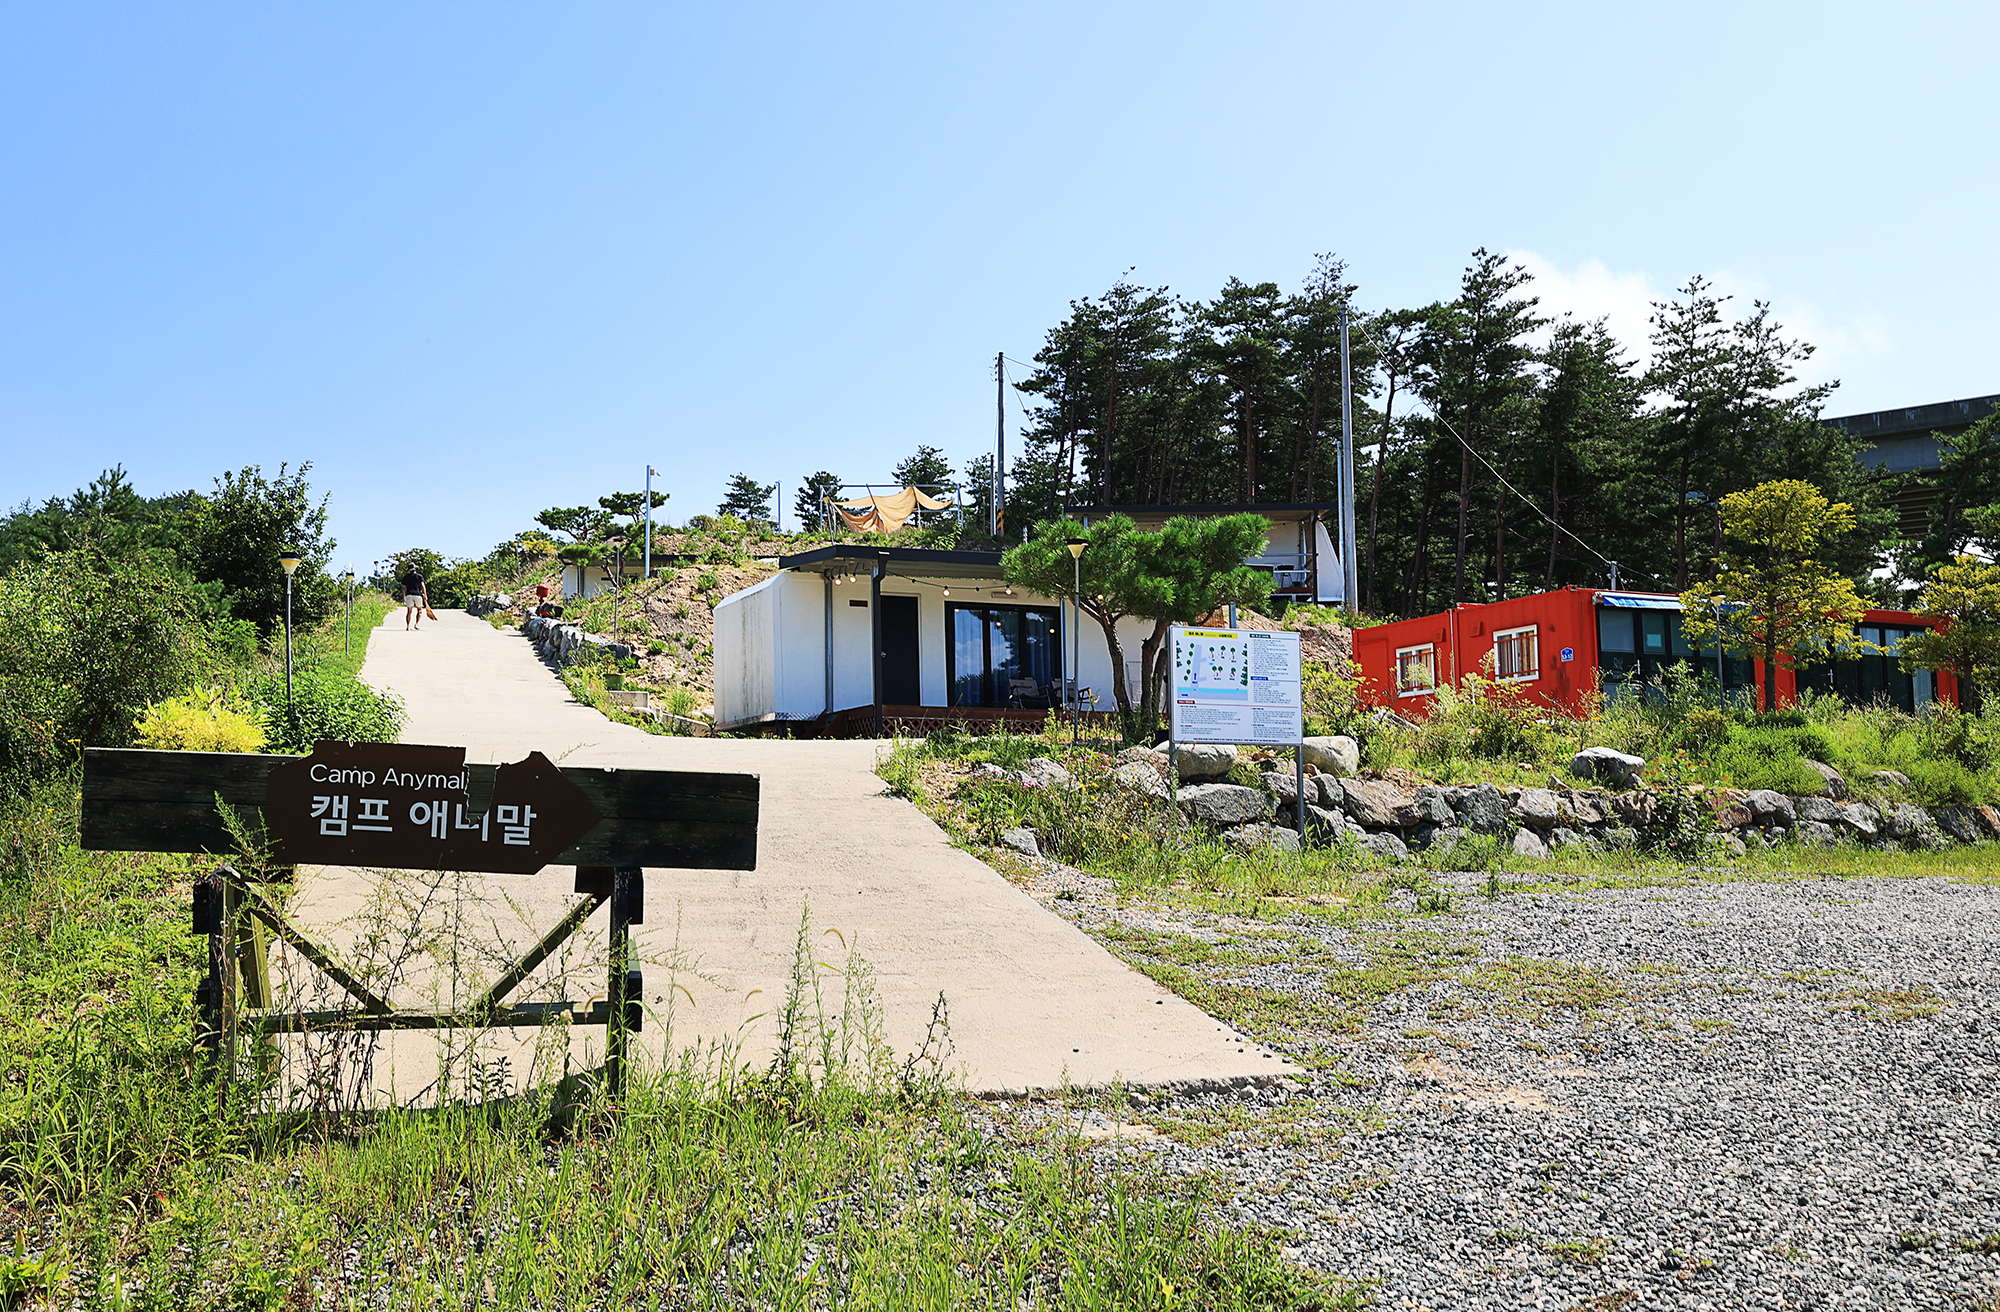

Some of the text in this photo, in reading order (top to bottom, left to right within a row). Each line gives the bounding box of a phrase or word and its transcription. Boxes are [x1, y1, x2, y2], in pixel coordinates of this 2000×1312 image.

[310, 763, 465, 790] Camp Anymal
[310, 795, 393, 837] 캠프
